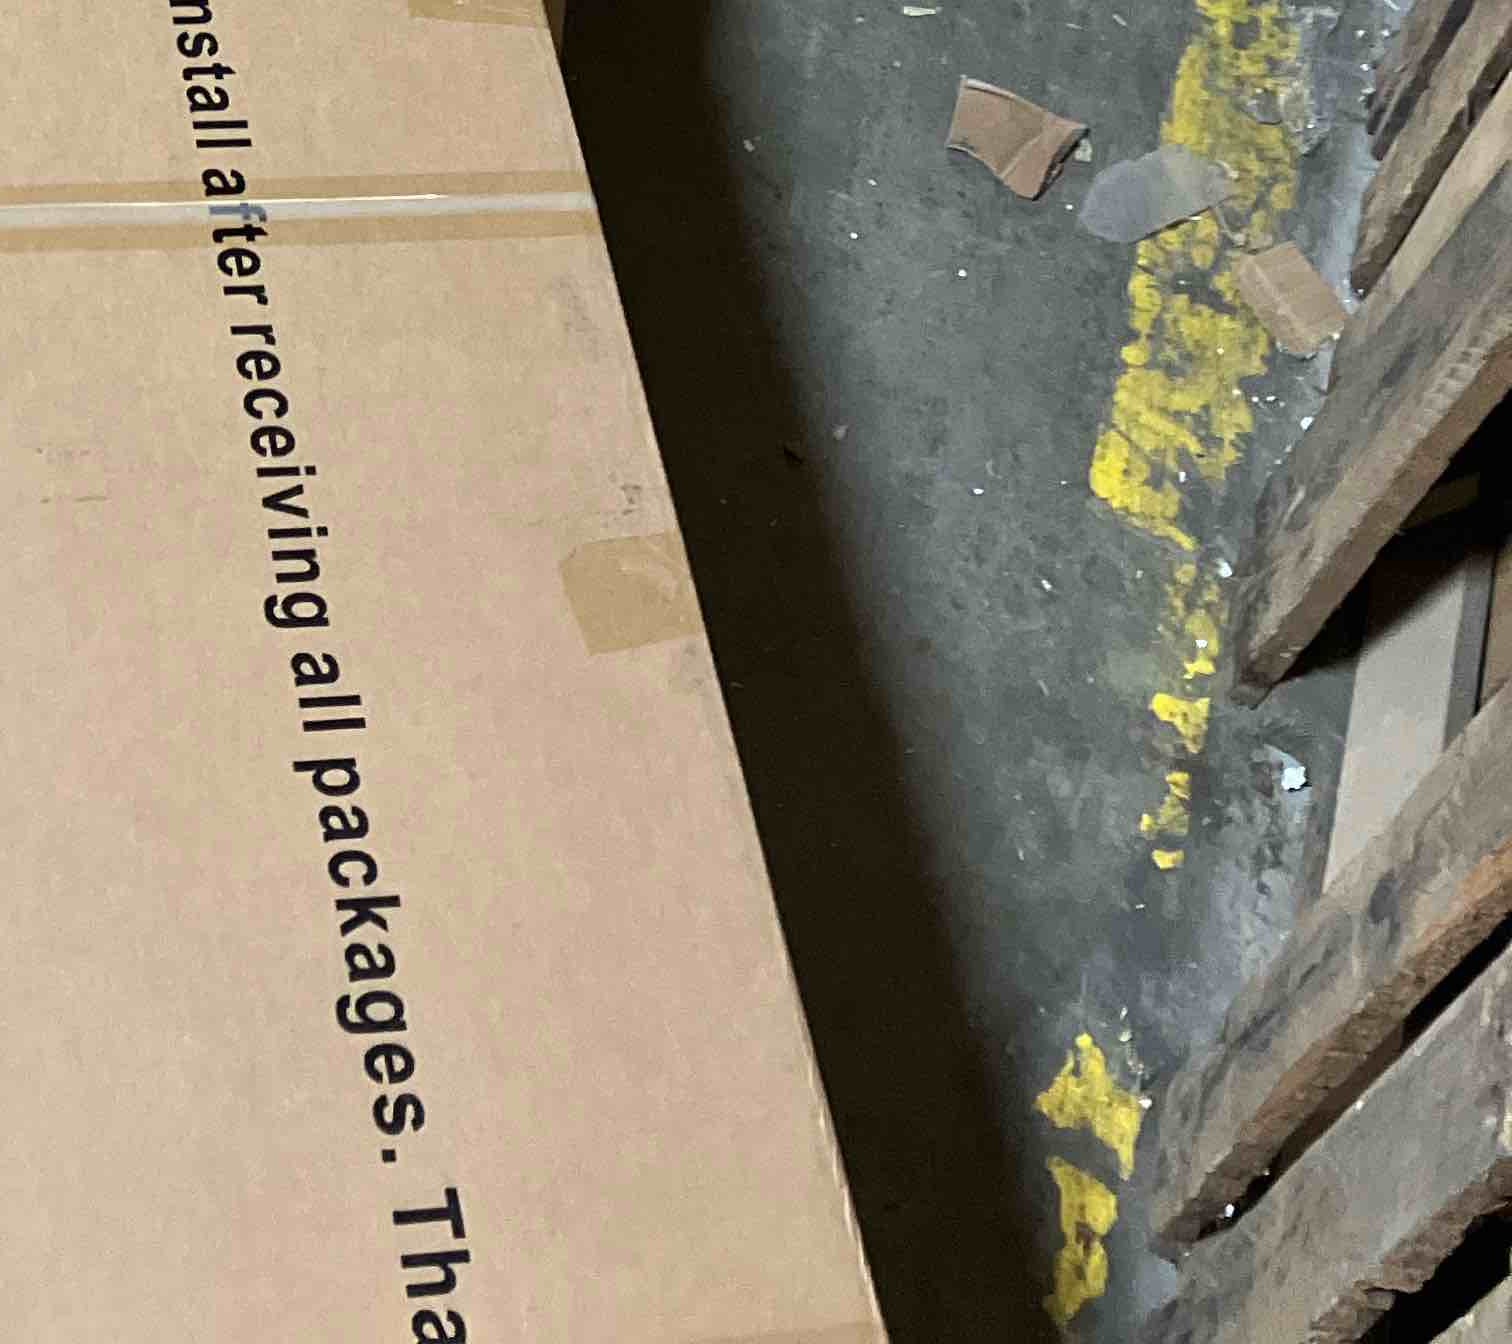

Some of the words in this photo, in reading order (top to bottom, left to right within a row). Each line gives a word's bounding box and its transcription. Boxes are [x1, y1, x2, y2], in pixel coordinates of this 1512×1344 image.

[202, 169, 268, 305] after
[230, 325, 330, 628] receiving
[291, 653, 366, 732] all
[292, 758, 425, 1163] packages.
[392, 1187, 471, 1344] Tha
